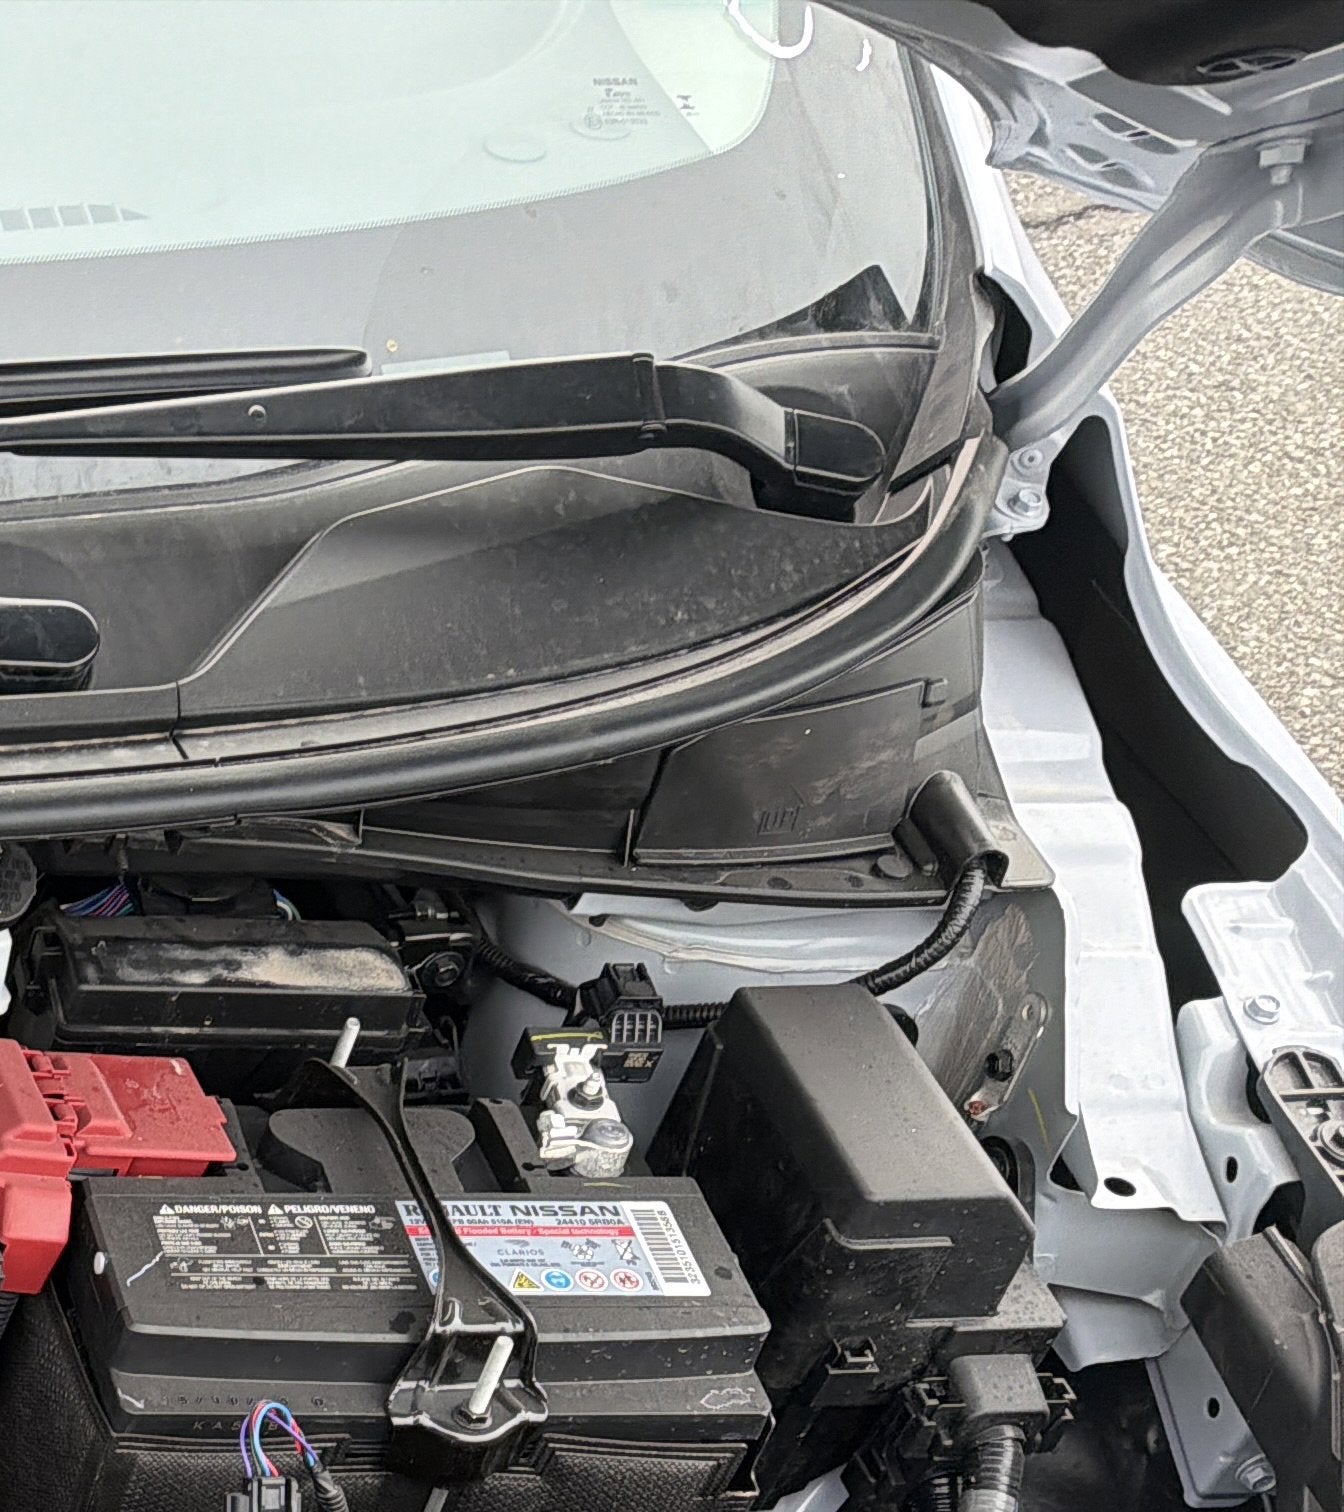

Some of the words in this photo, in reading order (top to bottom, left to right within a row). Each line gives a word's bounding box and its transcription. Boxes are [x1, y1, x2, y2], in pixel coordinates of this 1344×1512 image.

[174, 1205, 263, 1214] DANGER/POISON
[283, 1204, 376, 1215] PELIGRO/VENENO
[402, 1204, 503, 1217] RAULT
[509, 1204, 622, 1217] NISSAN
[497, 1248, 545, 1256] CLARIOS
